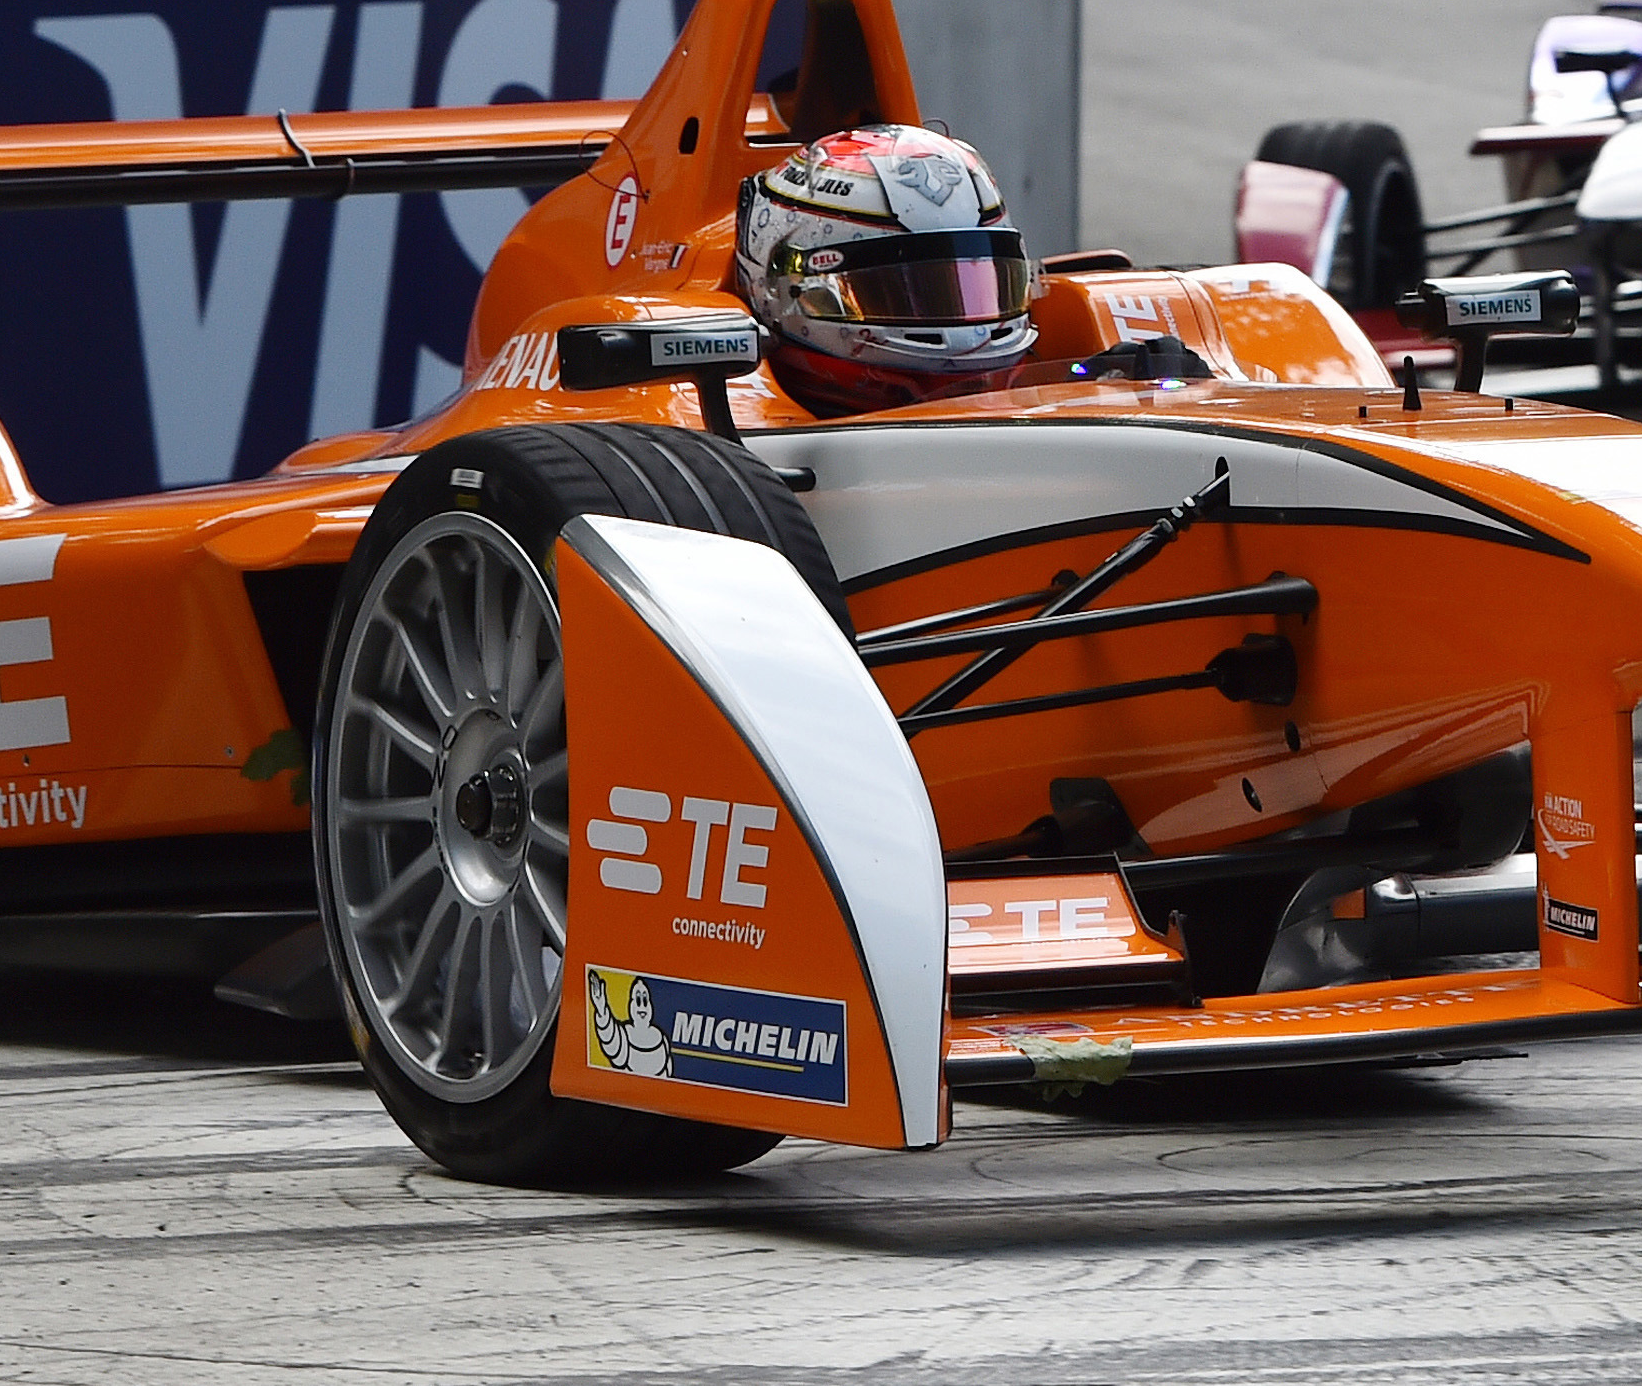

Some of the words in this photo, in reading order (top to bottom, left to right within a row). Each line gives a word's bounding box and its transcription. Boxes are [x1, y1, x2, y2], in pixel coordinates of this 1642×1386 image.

[812, 254, 839, 266] BELL
[1459, 298, 1532, 316] SIEMENS
[663, 337, 749, 357] SIEMENS
[681, 796, 778, 908] TE
[672, 916, 766, 950] connectivity
[1005, 897, 1108, 939] TE
[1550, 905, 1596, 932] MICHELIN
[672, 1011, 839, 1065] MICHELIN
